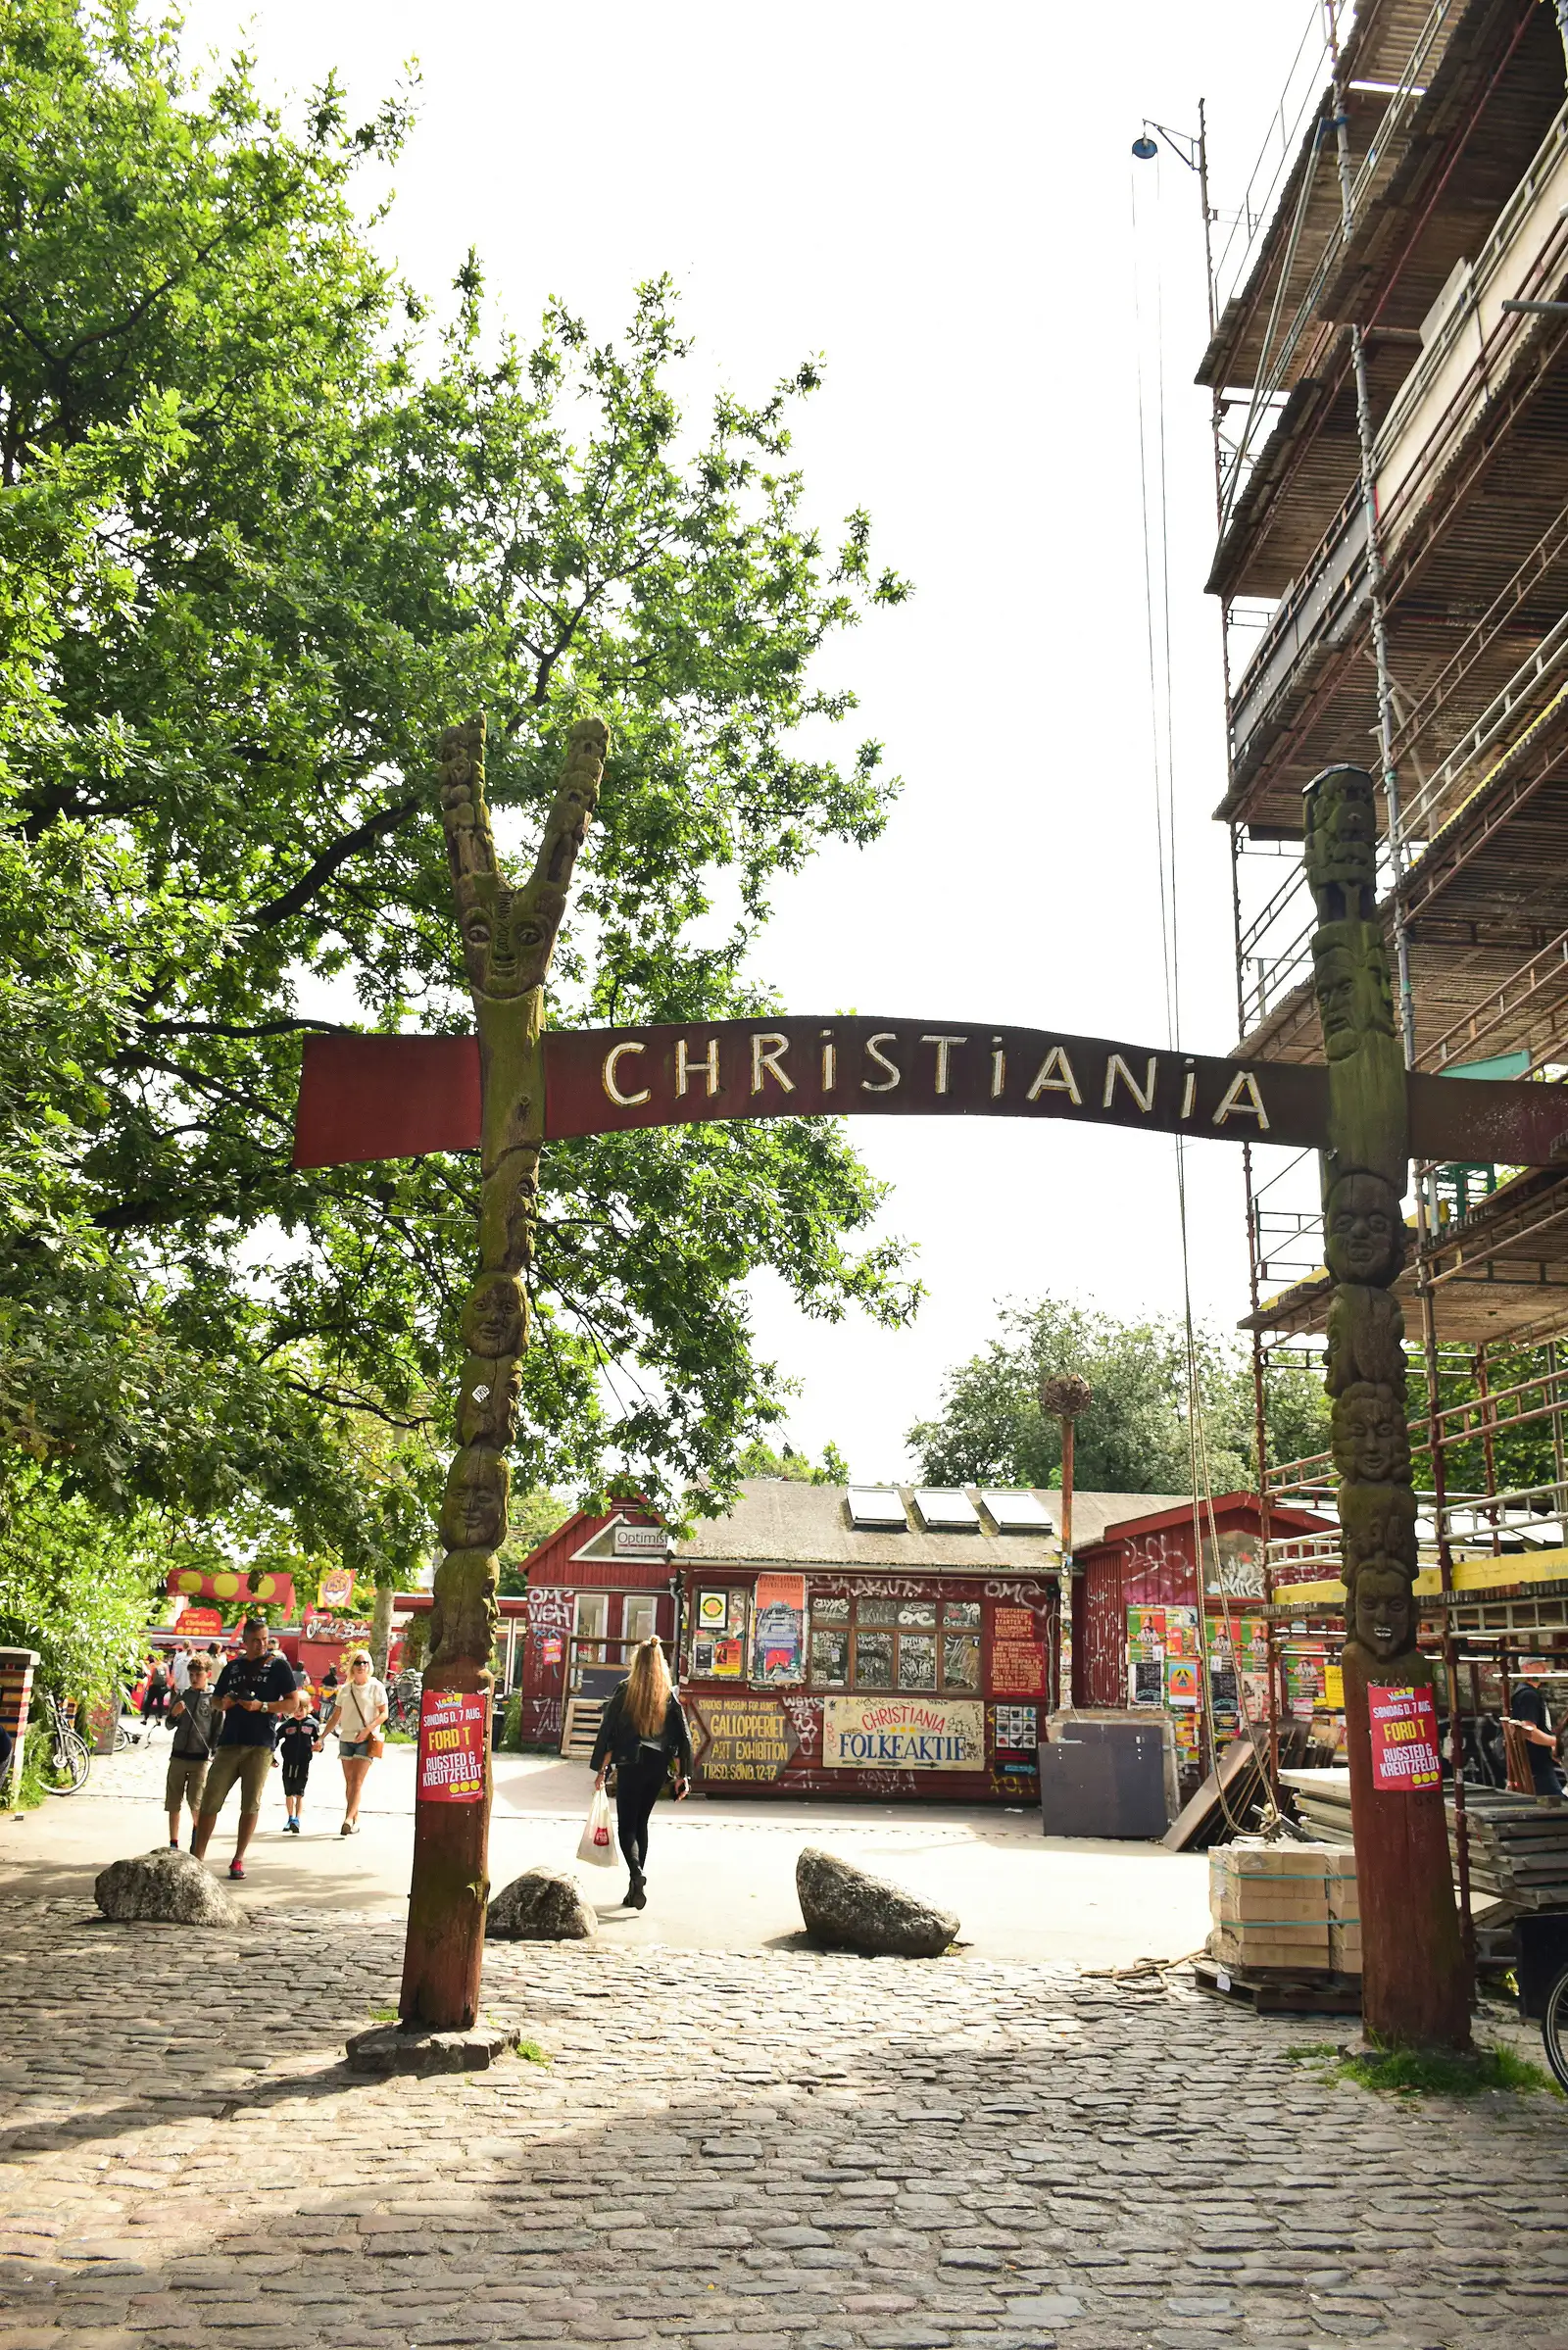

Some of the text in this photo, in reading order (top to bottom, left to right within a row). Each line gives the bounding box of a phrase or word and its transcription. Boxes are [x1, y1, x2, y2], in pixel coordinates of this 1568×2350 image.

[227, 1675, 269, 1686] ALTIUDE
[723, 1700, 747, 1711] MUSEUM
[748, 1701, 759, 1711] FOR
[1373, 1704, 1404, 1719] SØNDAG
[1411, 1702, 1417, 1714] 7
[423, 1711, 449, 1728] SØNDAG
[459, 1710, 465, 1722] 7
[466, 1707, 482, 1721] AUG.
[861, 1705, 946, 1735] CHRISTIANIA
[427, 1727, 470, 1751] FORD T
[1383, 1719, 1426, 1742] FORD T
[711, 1740, 732, 1760] ART
[839, 1734, 966, 1761] FOLKEAKTIE
[1383, 1744, 1426, 1763] RUGSTED
[425, 1752, 466, 1772] RUGSTED
[1379, 1755, 1441, 1778] KREUTZFELDT
[422, 1764, 482, 1787] KREUTZFELDT
